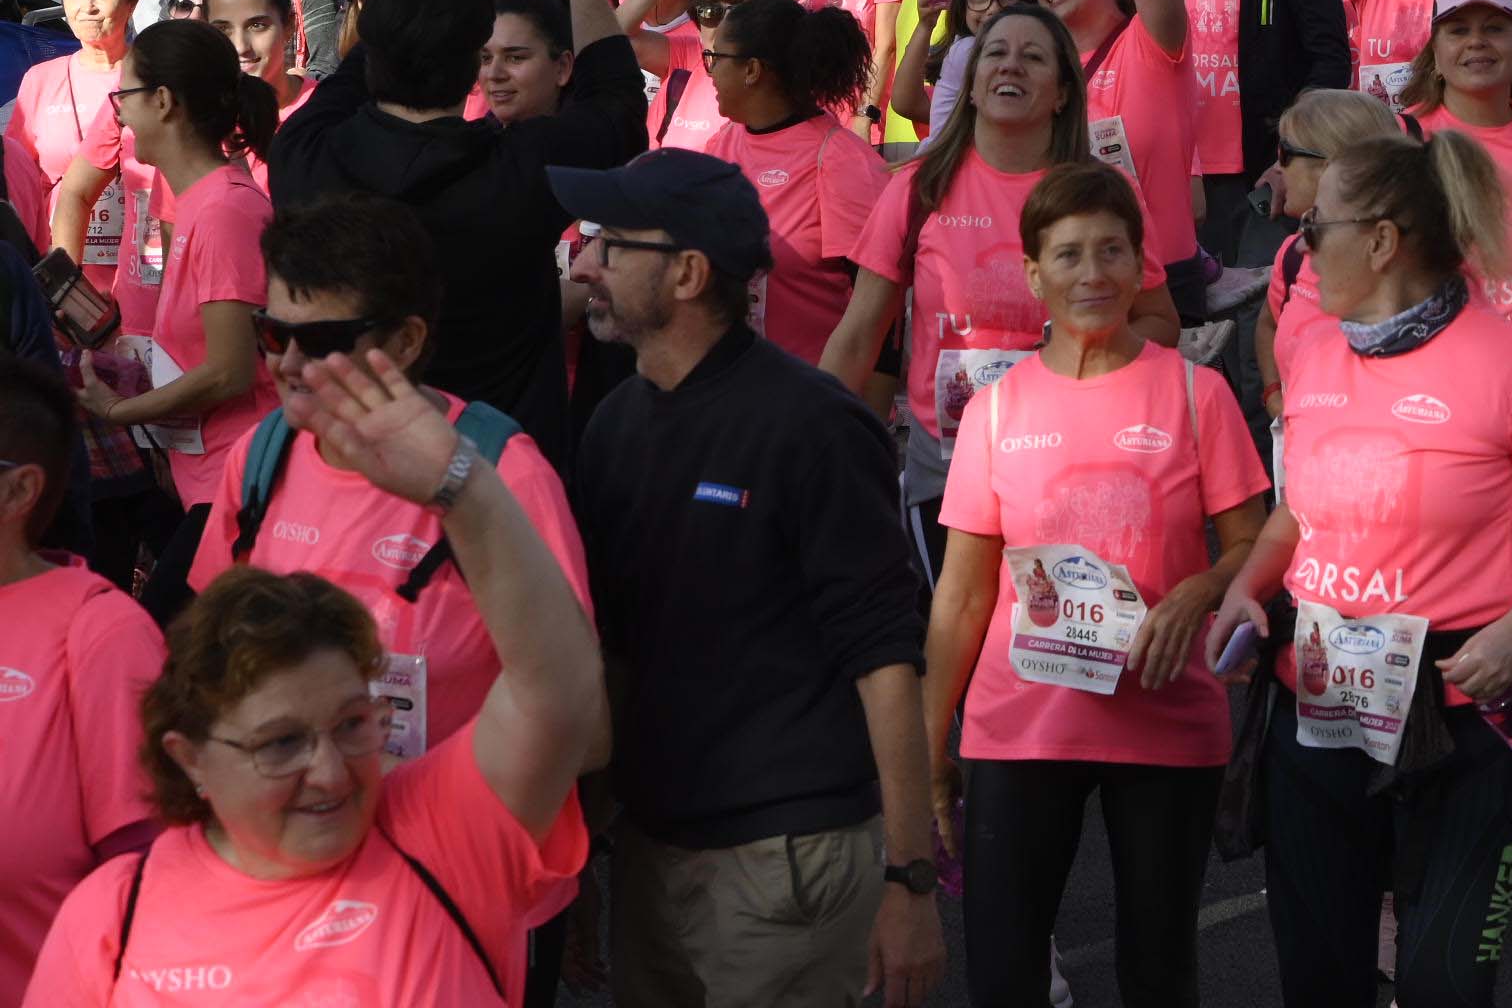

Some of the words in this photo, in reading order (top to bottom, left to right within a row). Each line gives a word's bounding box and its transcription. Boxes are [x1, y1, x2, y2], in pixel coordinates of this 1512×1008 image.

[1368, 38, 1391, 58] TU
[90, 209, 110, 223] 16
[937, 215, 992, 229] OYSHO
[935, 311, 973, 340] TU
[1299, 392, 1348, 408] OYSHO
[1001, 432, 1063, 454] OYSHO
[272, 521, 320, 545] OYSHO
[1063, 598, 1104, 624] 016
[1066, 625, 1098, 643] 28445
[1028, 639, 1066, 652] CARRERA
[1077, 648, 1087, 657] LA
[1021, 657, 1066, 674] OYSHO
[384, 674, 412, 687] UMA
[1332, 665, 1375, 689] 016
